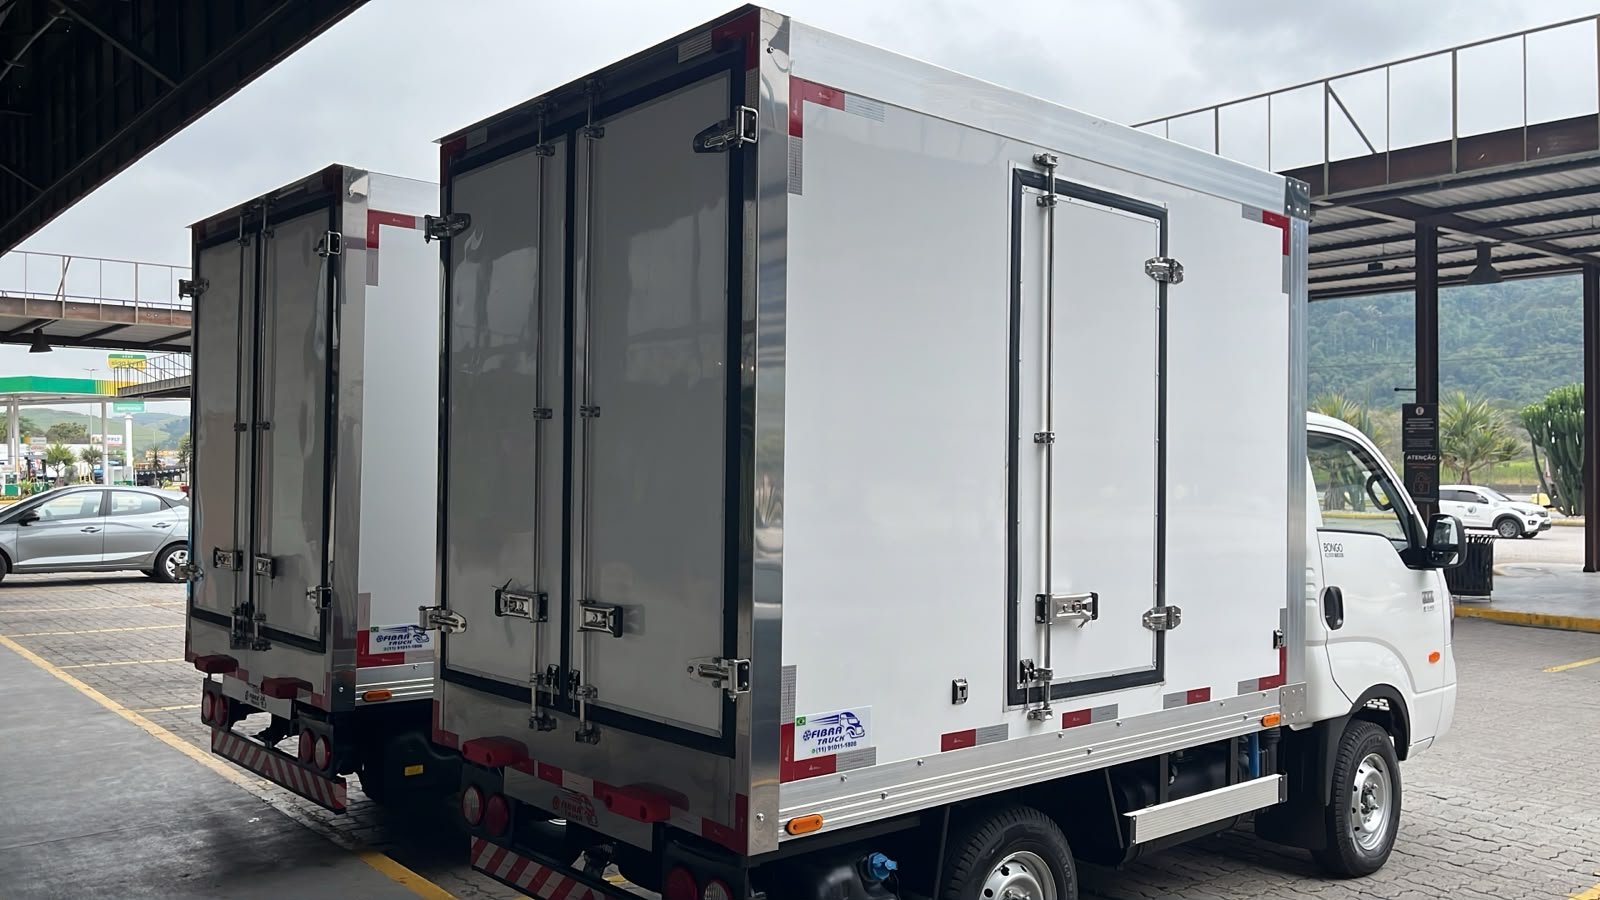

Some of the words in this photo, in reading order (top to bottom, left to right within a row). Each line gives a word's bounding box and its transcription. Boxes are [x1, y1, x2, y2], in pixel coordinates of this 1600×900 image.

[1323, 542, 1344, 553] BONGO
[811, 726, 843, 739] FIBRA
[817, 735, 846, 746] TRUCK
[816, 746, 827, 754] (11)
